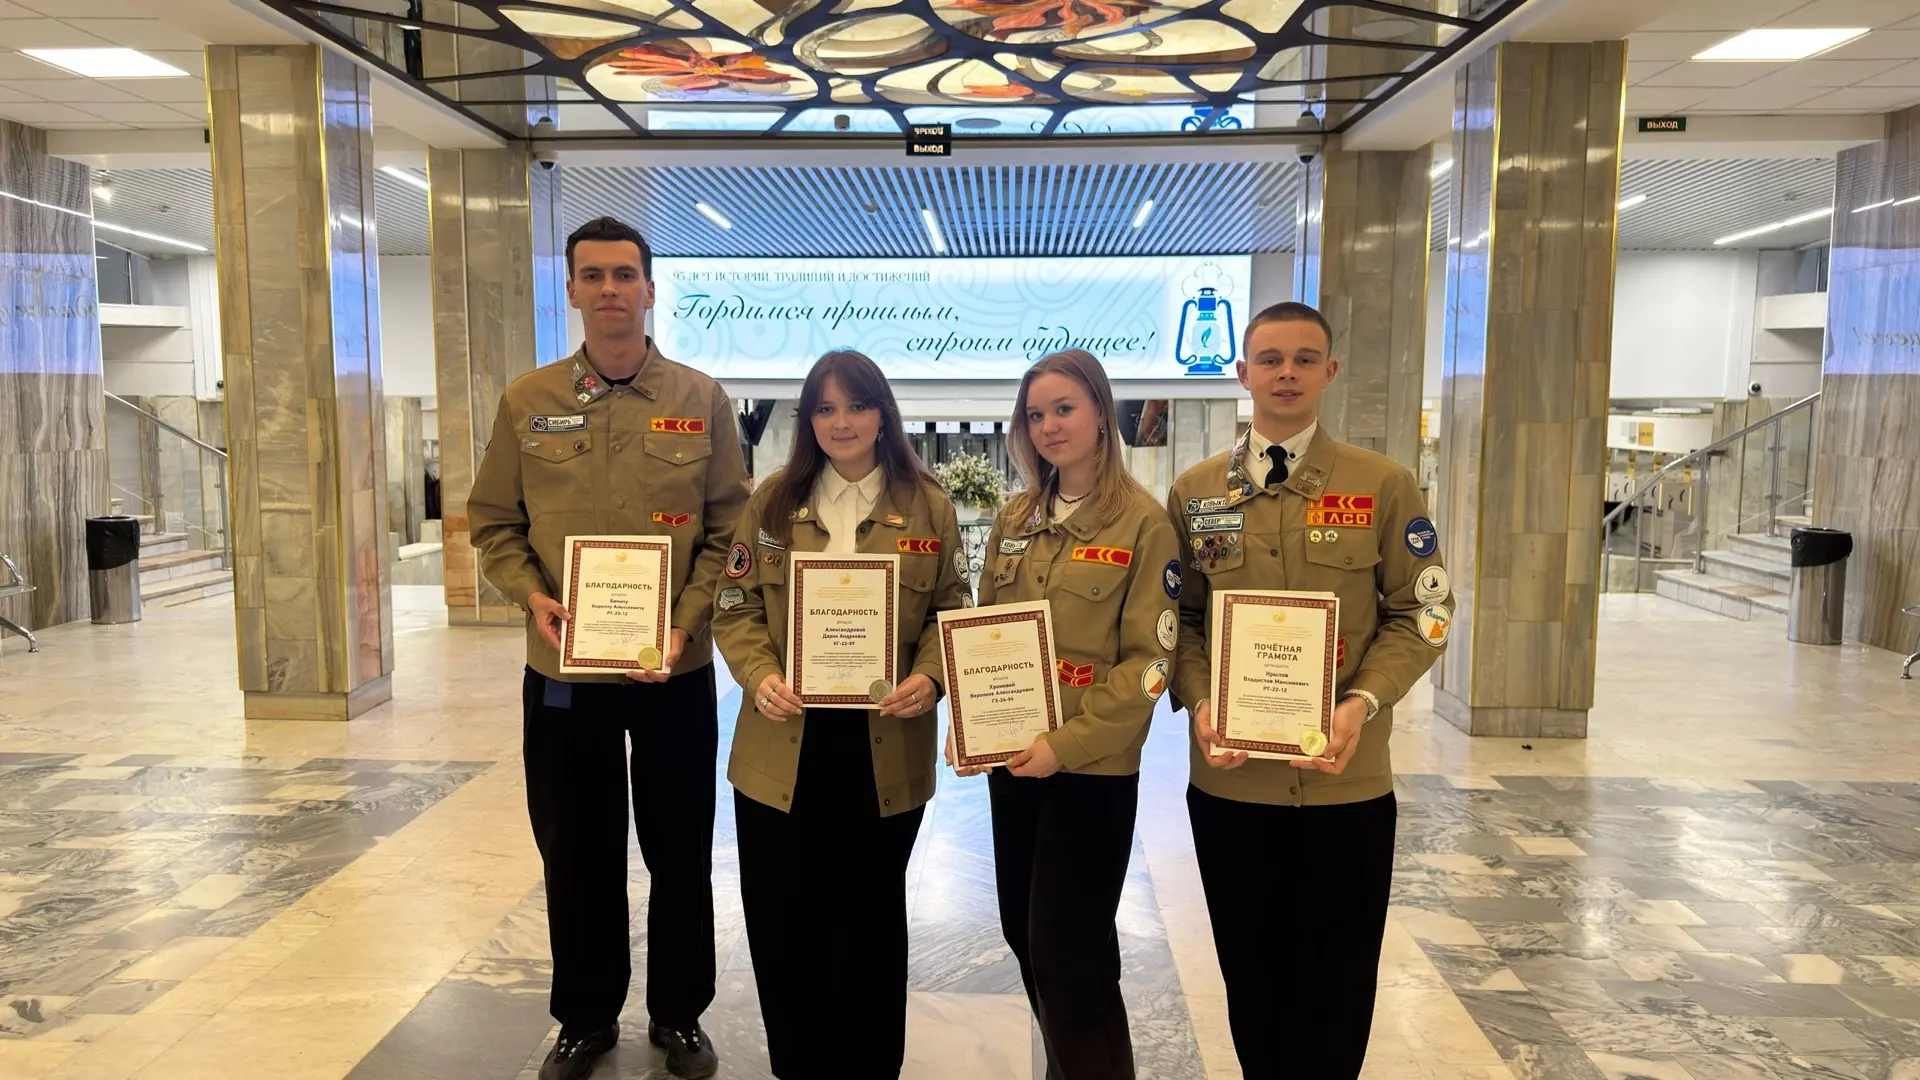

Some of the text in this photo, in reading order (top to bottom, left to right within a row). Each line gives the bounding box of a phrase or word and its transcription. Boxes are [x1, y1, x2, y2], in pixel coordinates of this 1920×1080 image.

[1647, 121, 1678, 129] ВЫХОД
[914, 145, 943, 153] ВЫХОД
[673, 271, 686, 282] 95
[673, 294, 960, 330] Гордимся прошлым,
[906, 326, 1156, 361] строим будущее!
[1204, 518, 1221, 526] СЕВЕР
[1329, 513, 1368, 524] ЛСО
[585, 582, 652, 591] БЛАГОДАРНОСТЬ
[810, 608, 879, 616] БЛАГОДАРНОСТЬ
[1254, 643, 1302, 653] ПОЧЁТНАЯ
[1257, 652, 1298, 661] ГРАМОТА
[963, 661, 1034, 676] БЛАГОДАРНОСТЬ
[996, 687, 1034, 696] Александровне
